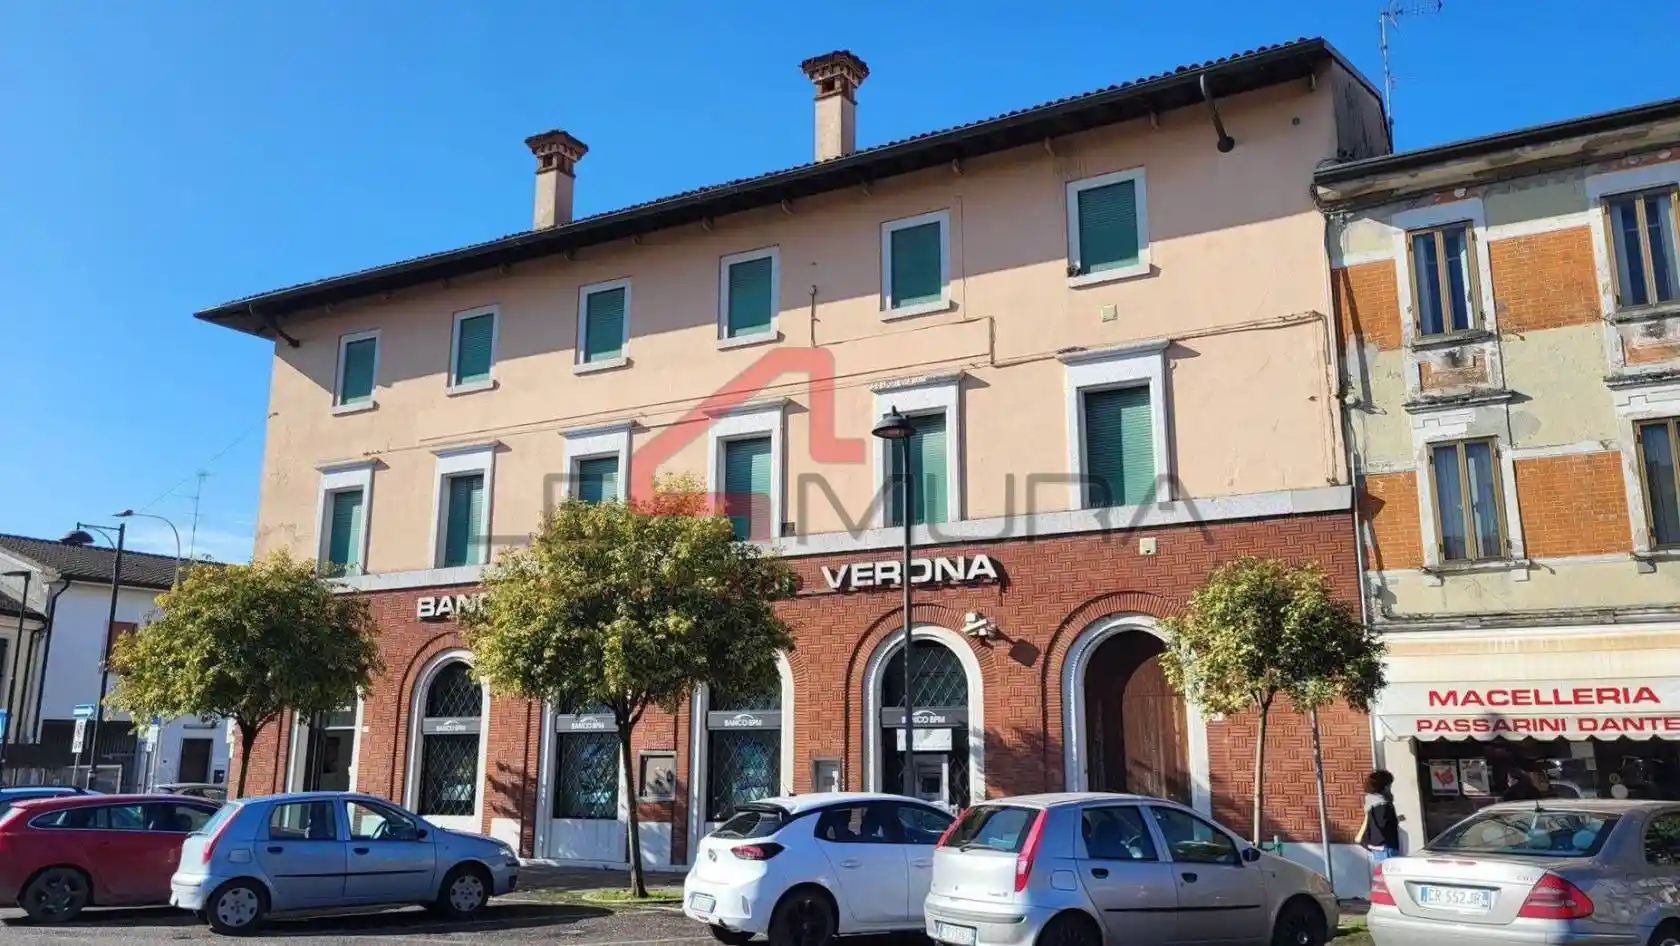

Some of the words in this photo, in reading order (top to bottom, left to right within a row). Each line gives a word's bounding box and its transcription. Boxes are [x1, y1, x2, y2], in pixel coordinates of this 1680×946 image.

[820, 553, 998, 590] VERONA
[1428, 686, 1661, 707] MACELLERIA
[1416, 717, 1568, 733] PASSARINI
[1577, 716, 1680, 732] DANTE
